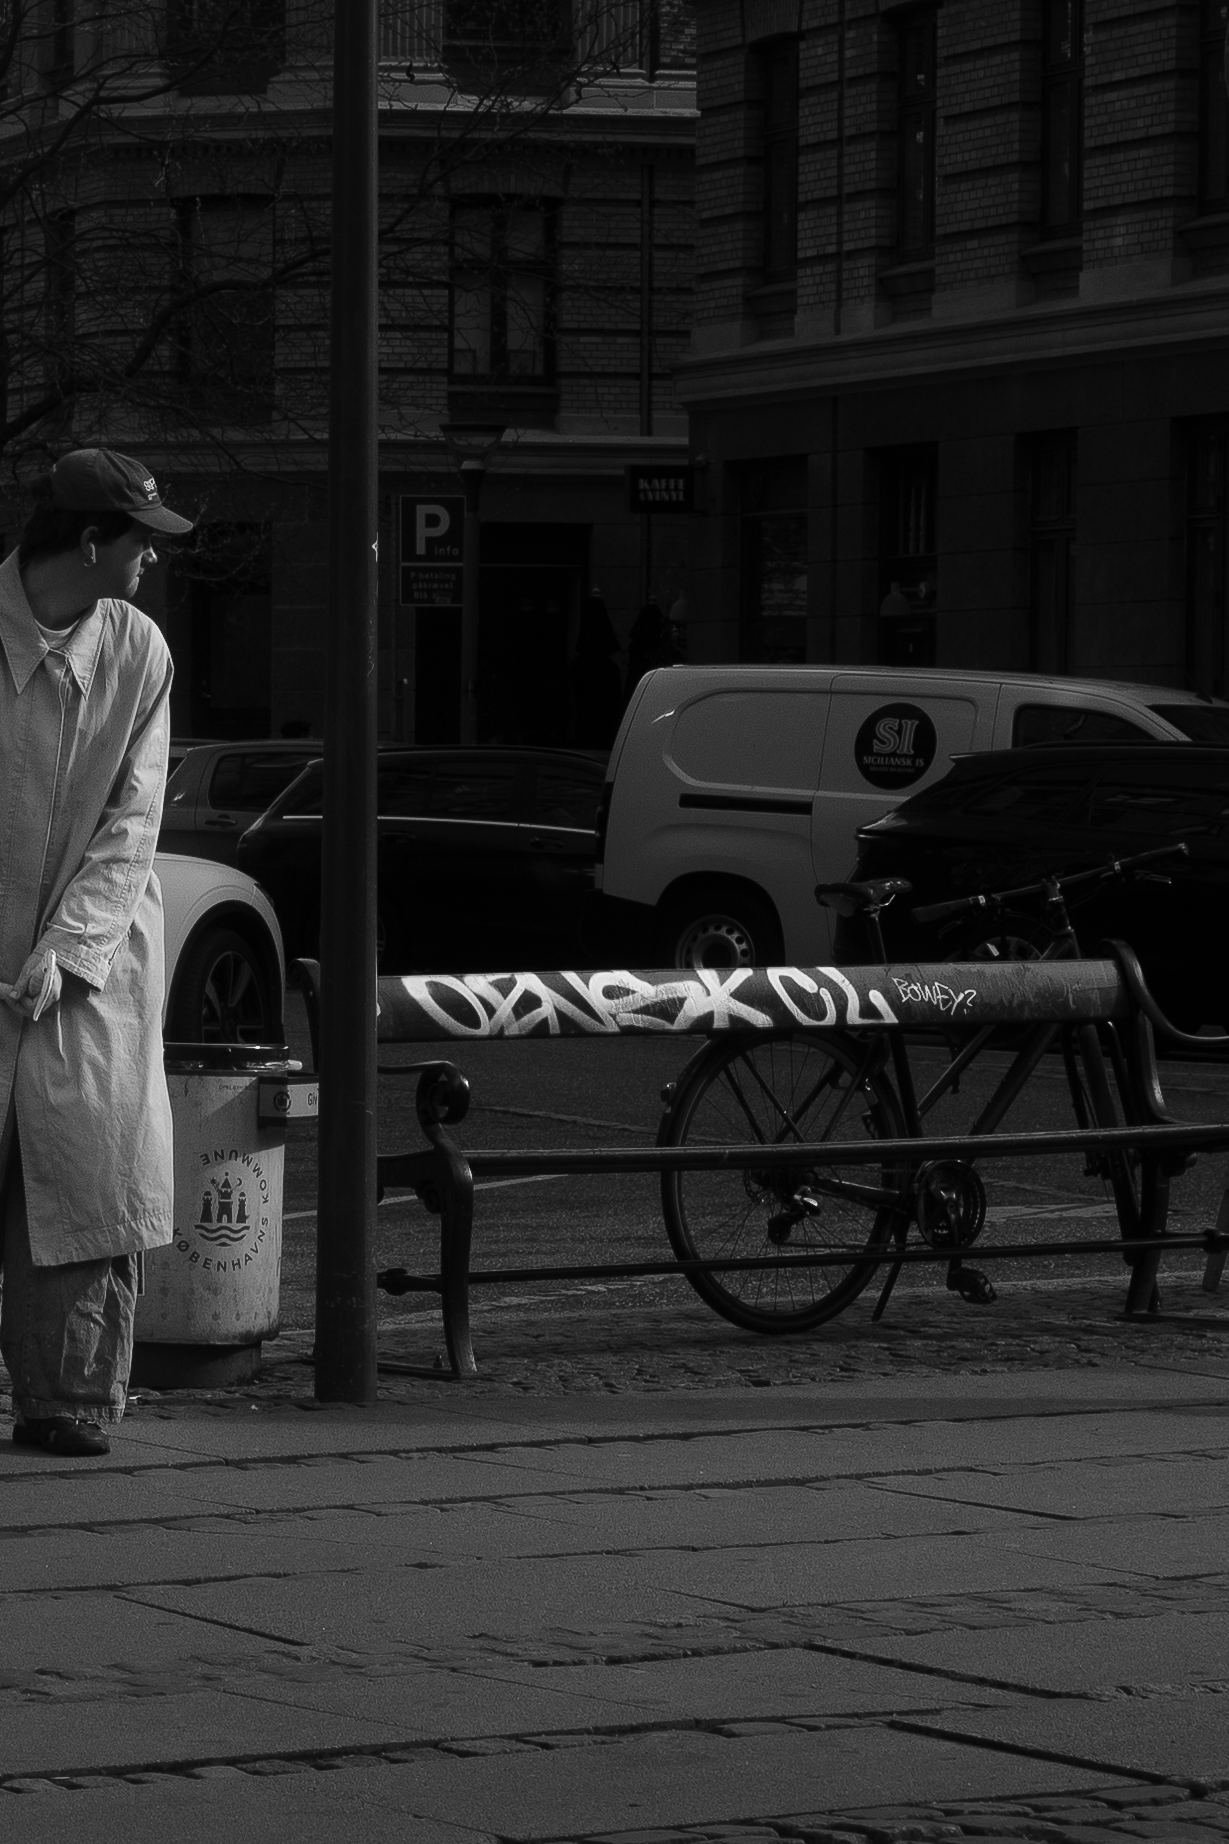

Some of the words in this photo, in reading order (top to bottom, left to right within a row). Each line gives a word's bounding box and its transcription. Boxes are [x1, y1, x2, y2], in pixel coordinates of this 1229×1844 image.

[637, 477, 686, 490] KAFFE
[416, 504, 451, 555] P
[434, 544, 460, 556] info
[872, 717, 919, 755] SI
[862, 755, 914, 766] SICILIANSK
[915, 757, 925, 768] IS
[199, 1149, 269, 1205] KOMMUNE
